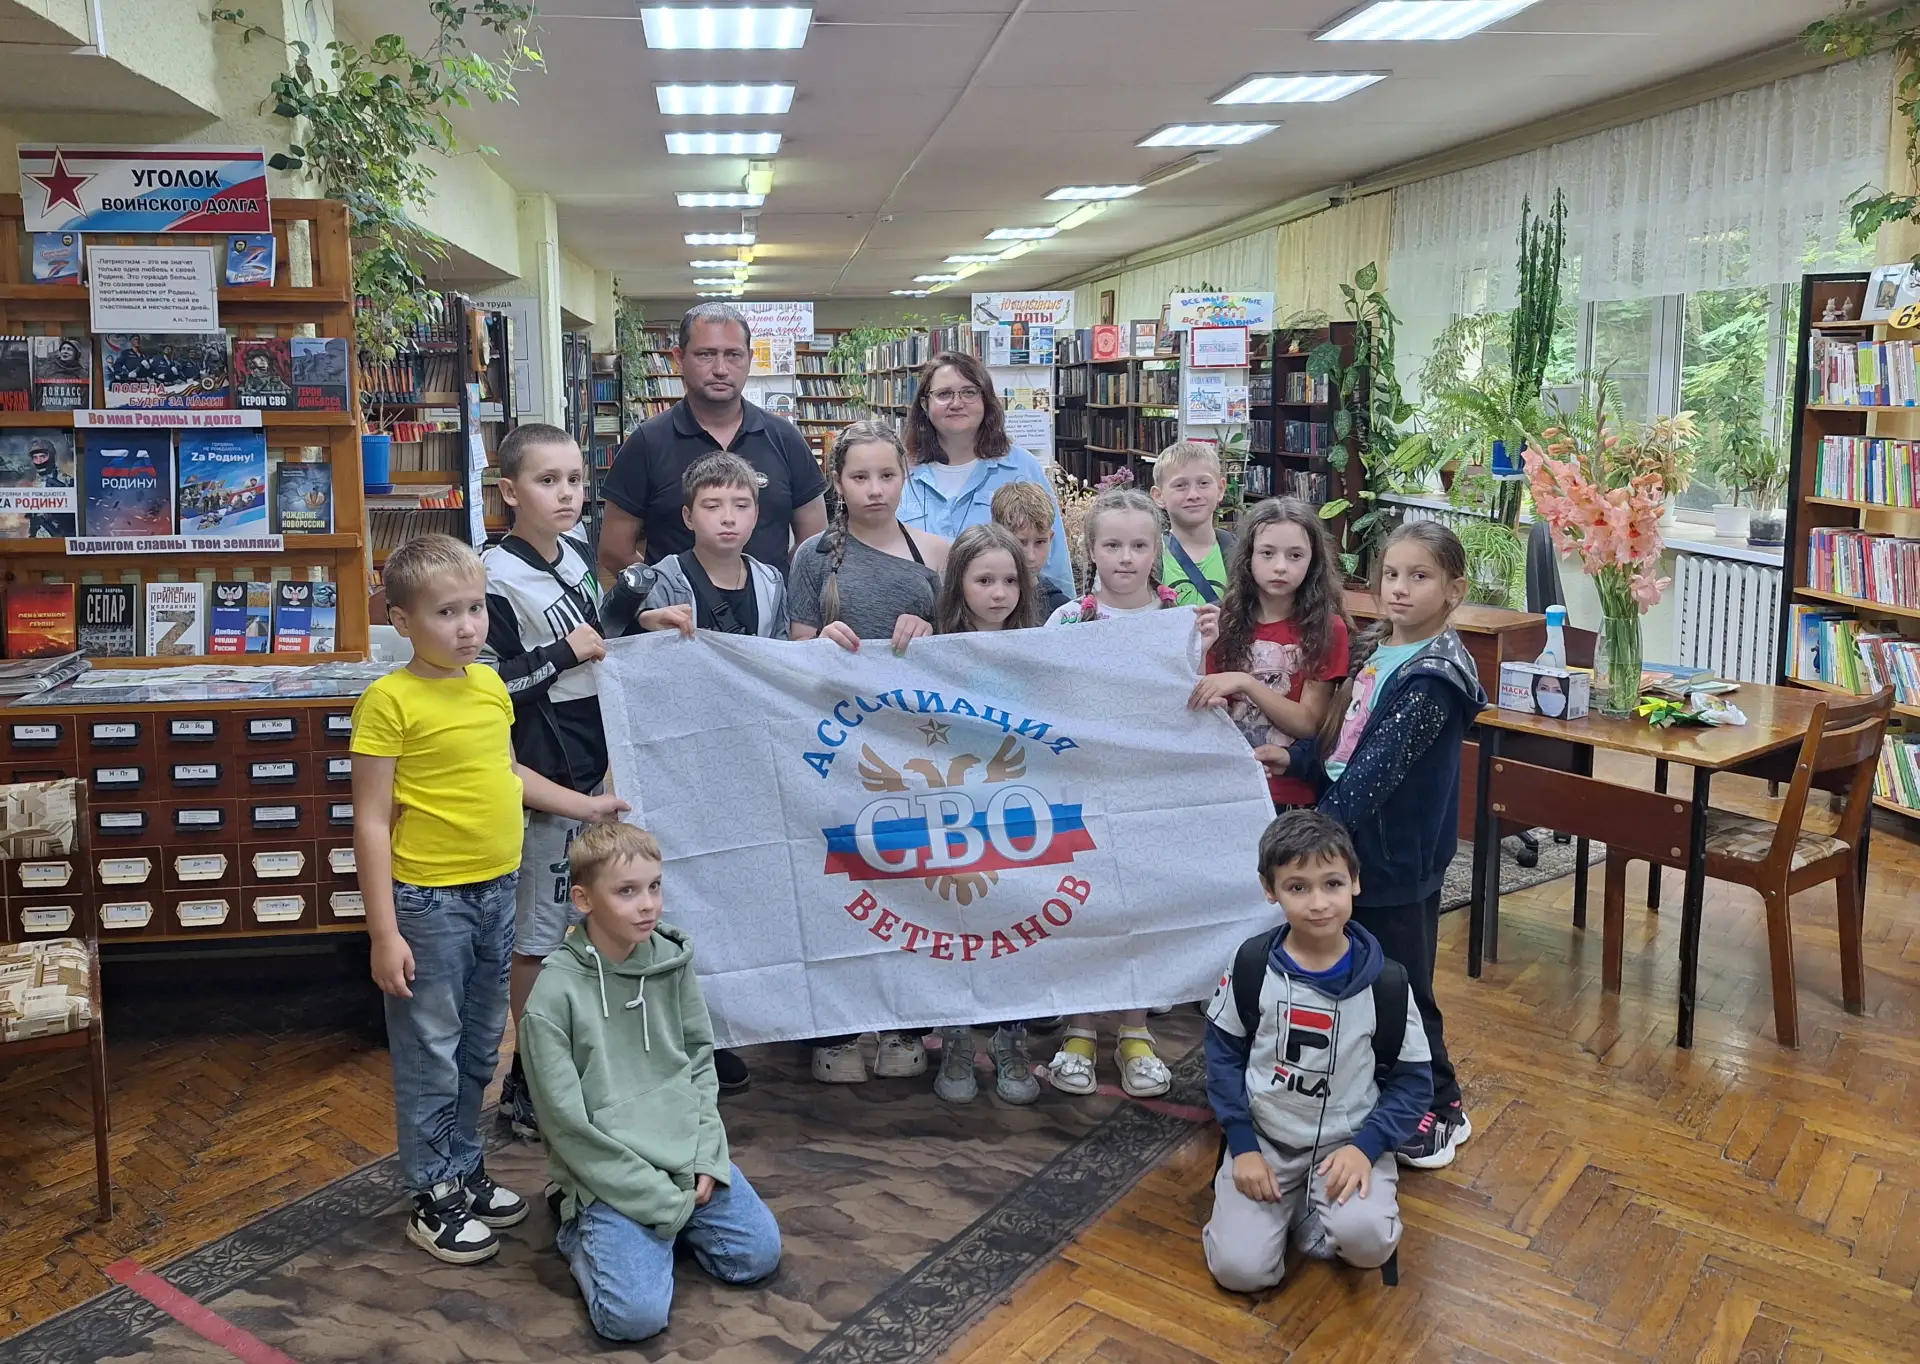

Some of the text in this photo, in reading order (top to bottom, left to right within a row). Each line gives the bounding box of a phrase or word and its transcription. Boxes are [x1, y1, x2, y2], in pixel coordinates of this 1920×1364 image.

[131, 168, 222, 189] УГОЛОК
[101, 197, 259, 214] ВОИНСКОГО ДОЛГА
[486, 300, 512, 308] труда
[1180, 295, 1264, 307] ВСЕ МЫ РНЫЕ,
[1181, 316, 1200, 326] ВСЕ
[1221, 317, 1264, 326] РАВНЫЕ
[42, 386, 81, 396] ДОНБАСС
[297, 387, 322, 397] ГЕРОИ
[42, 396, 82, 407] ДОРОГА ДОМОЙ
[129, 396, 224, 408] БУДЕТ ЗА НАМИ!
[241, 396, 287, 406] ГЕРОИ СВО
[88, 412, 242, 427] Во имя Родины и долга
[207, 452, 254, 464] Родину!
[15, 497, 68, 511] РОДИНУ!
[281, 511, 317, 519] РОЖДЕНИЕ
[281, 520, 326, 529] НОВОРОССИИ
[69, 537, 281, 553] Подвигом славны твои земляки
[150, 592, 196, 604] ПРИЛЕПИН
[86, 594, 126, 624] СЕПАР
[214, 628, 242, 636] Донбасс
[278, 627, 306, 635] Донбасс
[1501, 685, 1530, 697] МАСКА
[801, 688, 1080, 779] АССОЦИАЦИЯ
[854, 784, 1055, 874] СВО
[844, 874, 1092, 962] ВЕТЕРАНОВ
[1270, 1065, 1331, 1099] FILA
